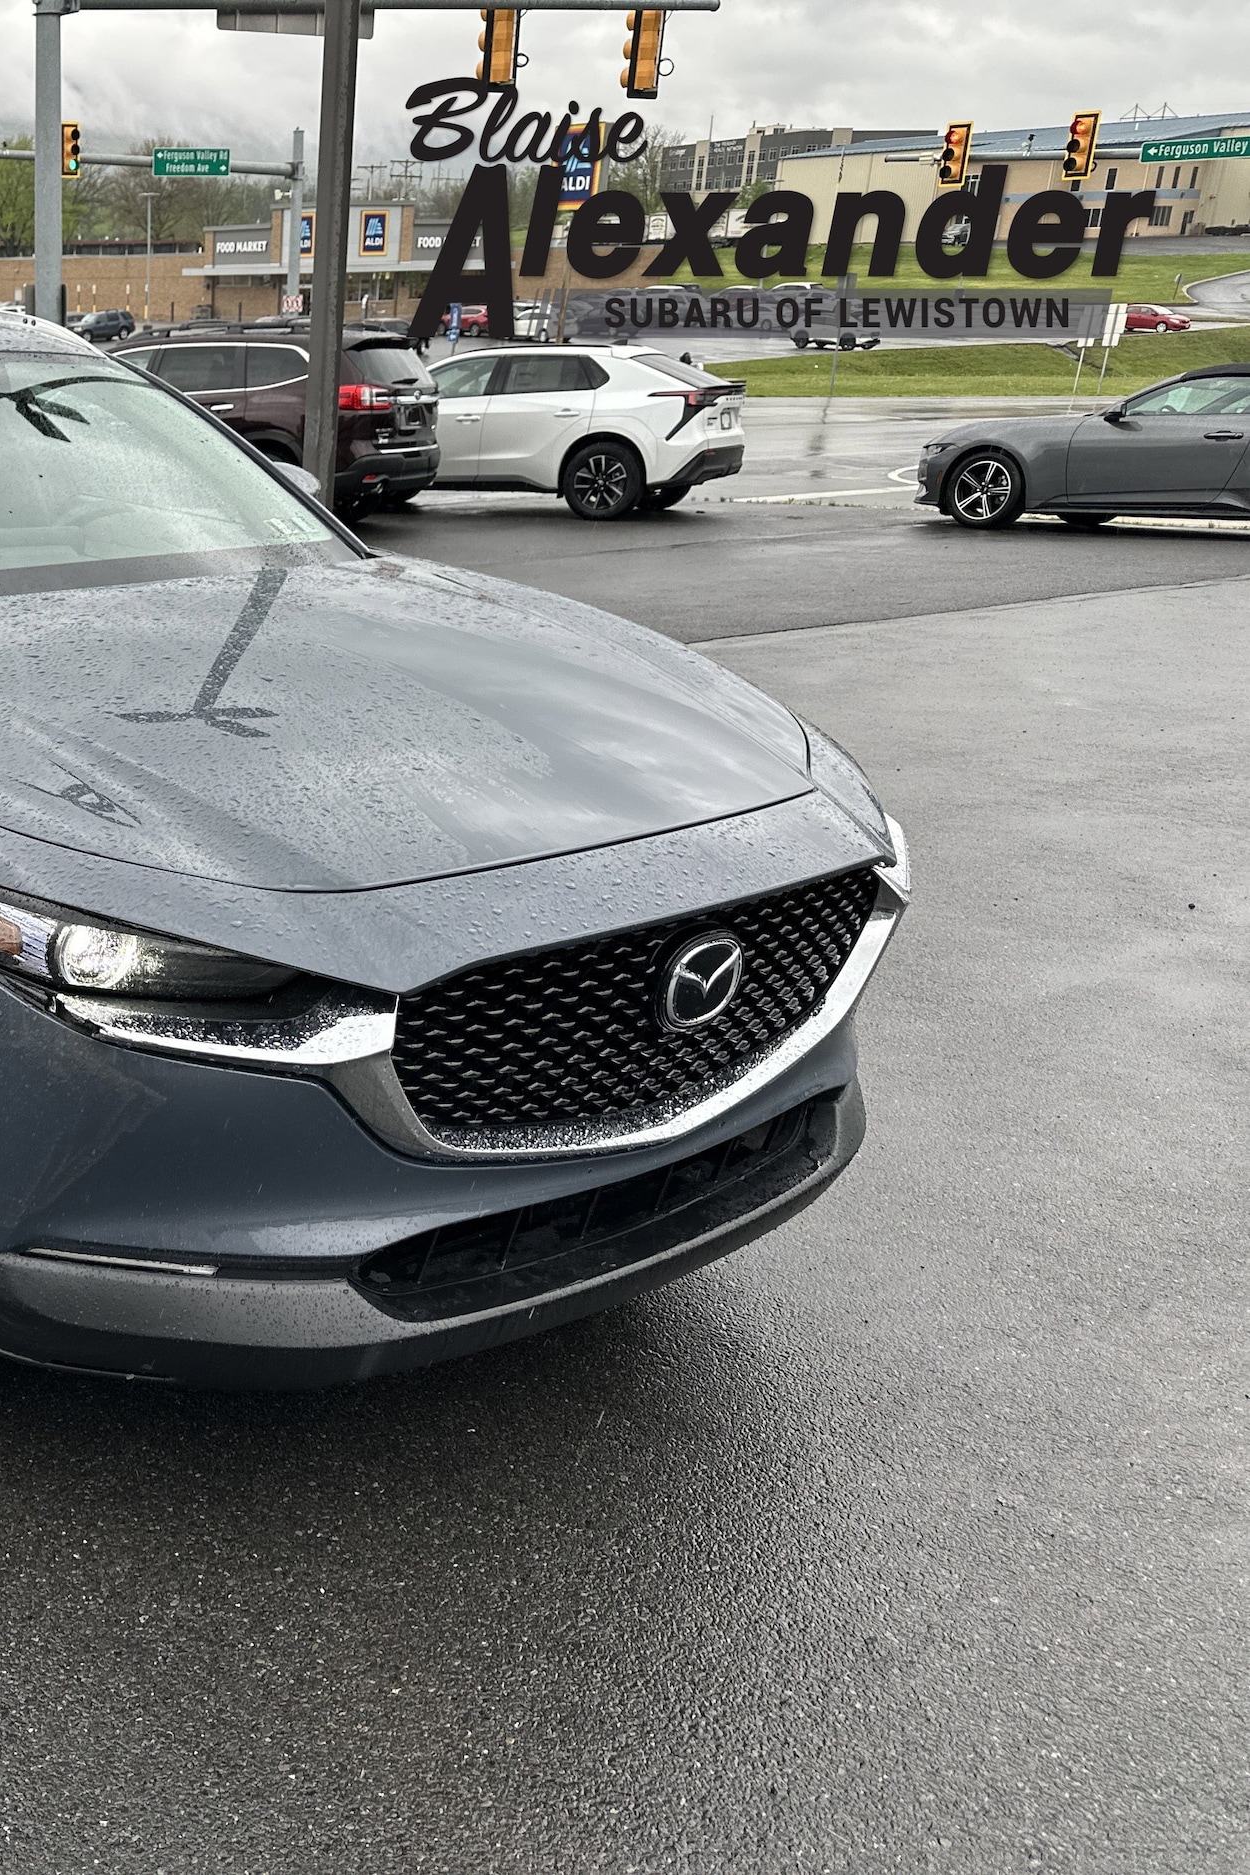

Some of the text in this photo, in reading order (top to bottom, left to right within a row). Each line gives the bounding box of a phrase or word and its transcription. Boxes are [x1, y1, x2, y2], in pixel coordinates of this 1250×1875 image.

[1158, 139, 1248, 158] Ferguson Valley
[164, 150, 228, 162] Ferguson Valley Rd
[166, 163, 209, 173] Freedom Ave
[561, 175, 591, 191] ALDI
[216, 240, 268, 253] FOOD MARKET
[300, 239, 311, 248] LDI
[364, 237, 384, 246] ALDI
[417, 236, 442, 248] FOOD
